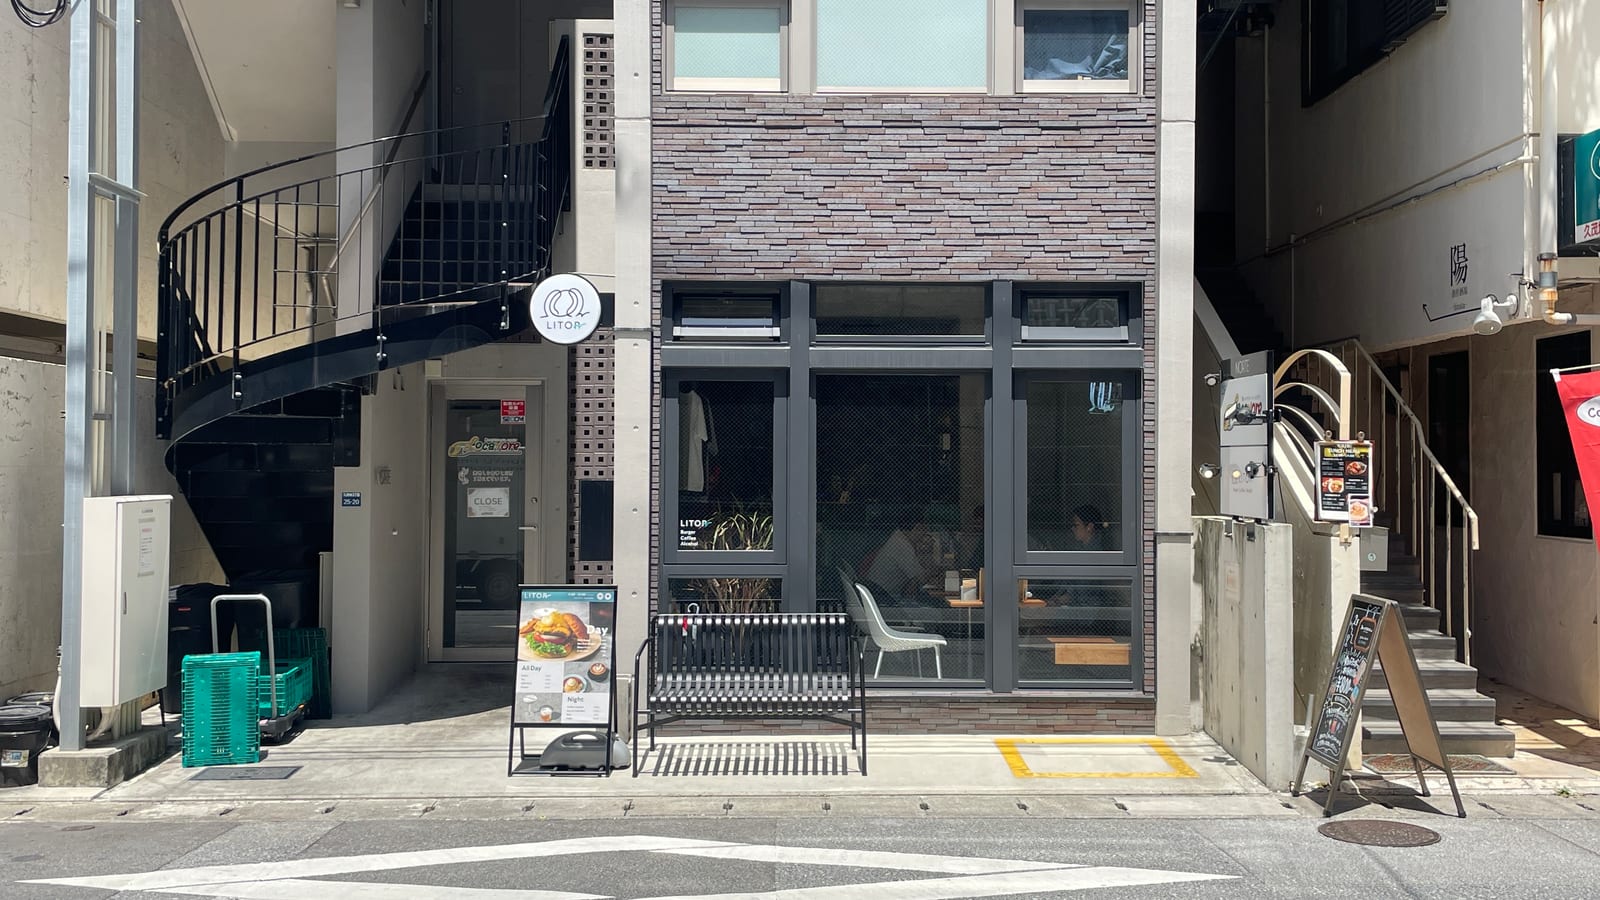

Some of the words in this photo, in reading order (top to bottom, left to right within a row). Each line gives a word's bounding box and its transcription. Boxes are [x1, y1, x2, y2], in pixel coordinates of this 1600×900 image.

[1450, 243, 1468, 287] 陽
[474, 497, 503, 505] CLOSE
[586, 625, 609, 637] Day
[530, 664, 542, 672] Day
